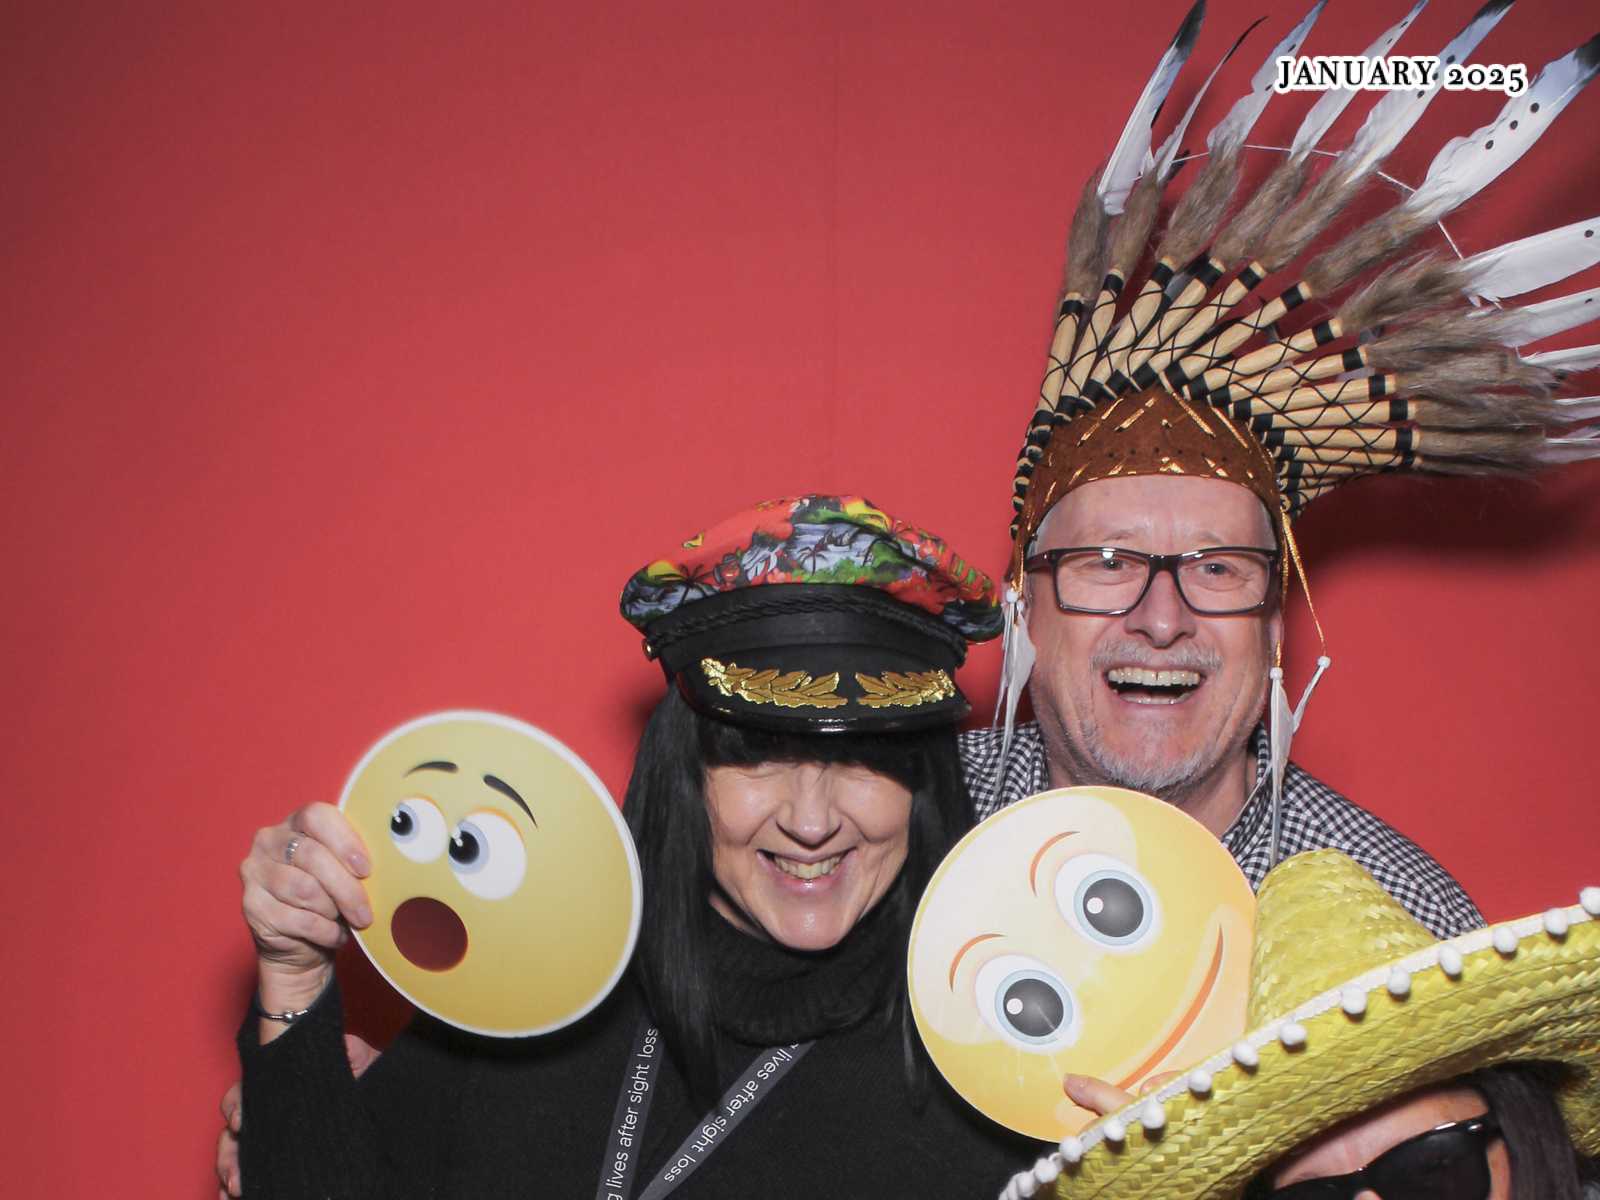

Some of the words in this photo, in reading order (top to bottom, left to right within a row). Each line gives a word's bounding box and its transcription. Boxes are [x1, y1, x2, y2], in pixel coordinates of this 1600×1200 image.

[636, 1028, 659, 1059] loss
[756, 1048, 793, 1080] lives
[627, 1063, 651, 1105] sight
[725, 1080, 760, 1118] after
[617, 1107, 640, 1148] after
[691, 1115, 728, 1154] sight
[606, 1151, 630, 1189] lives
[663, 1153, 697, 1184] loss
